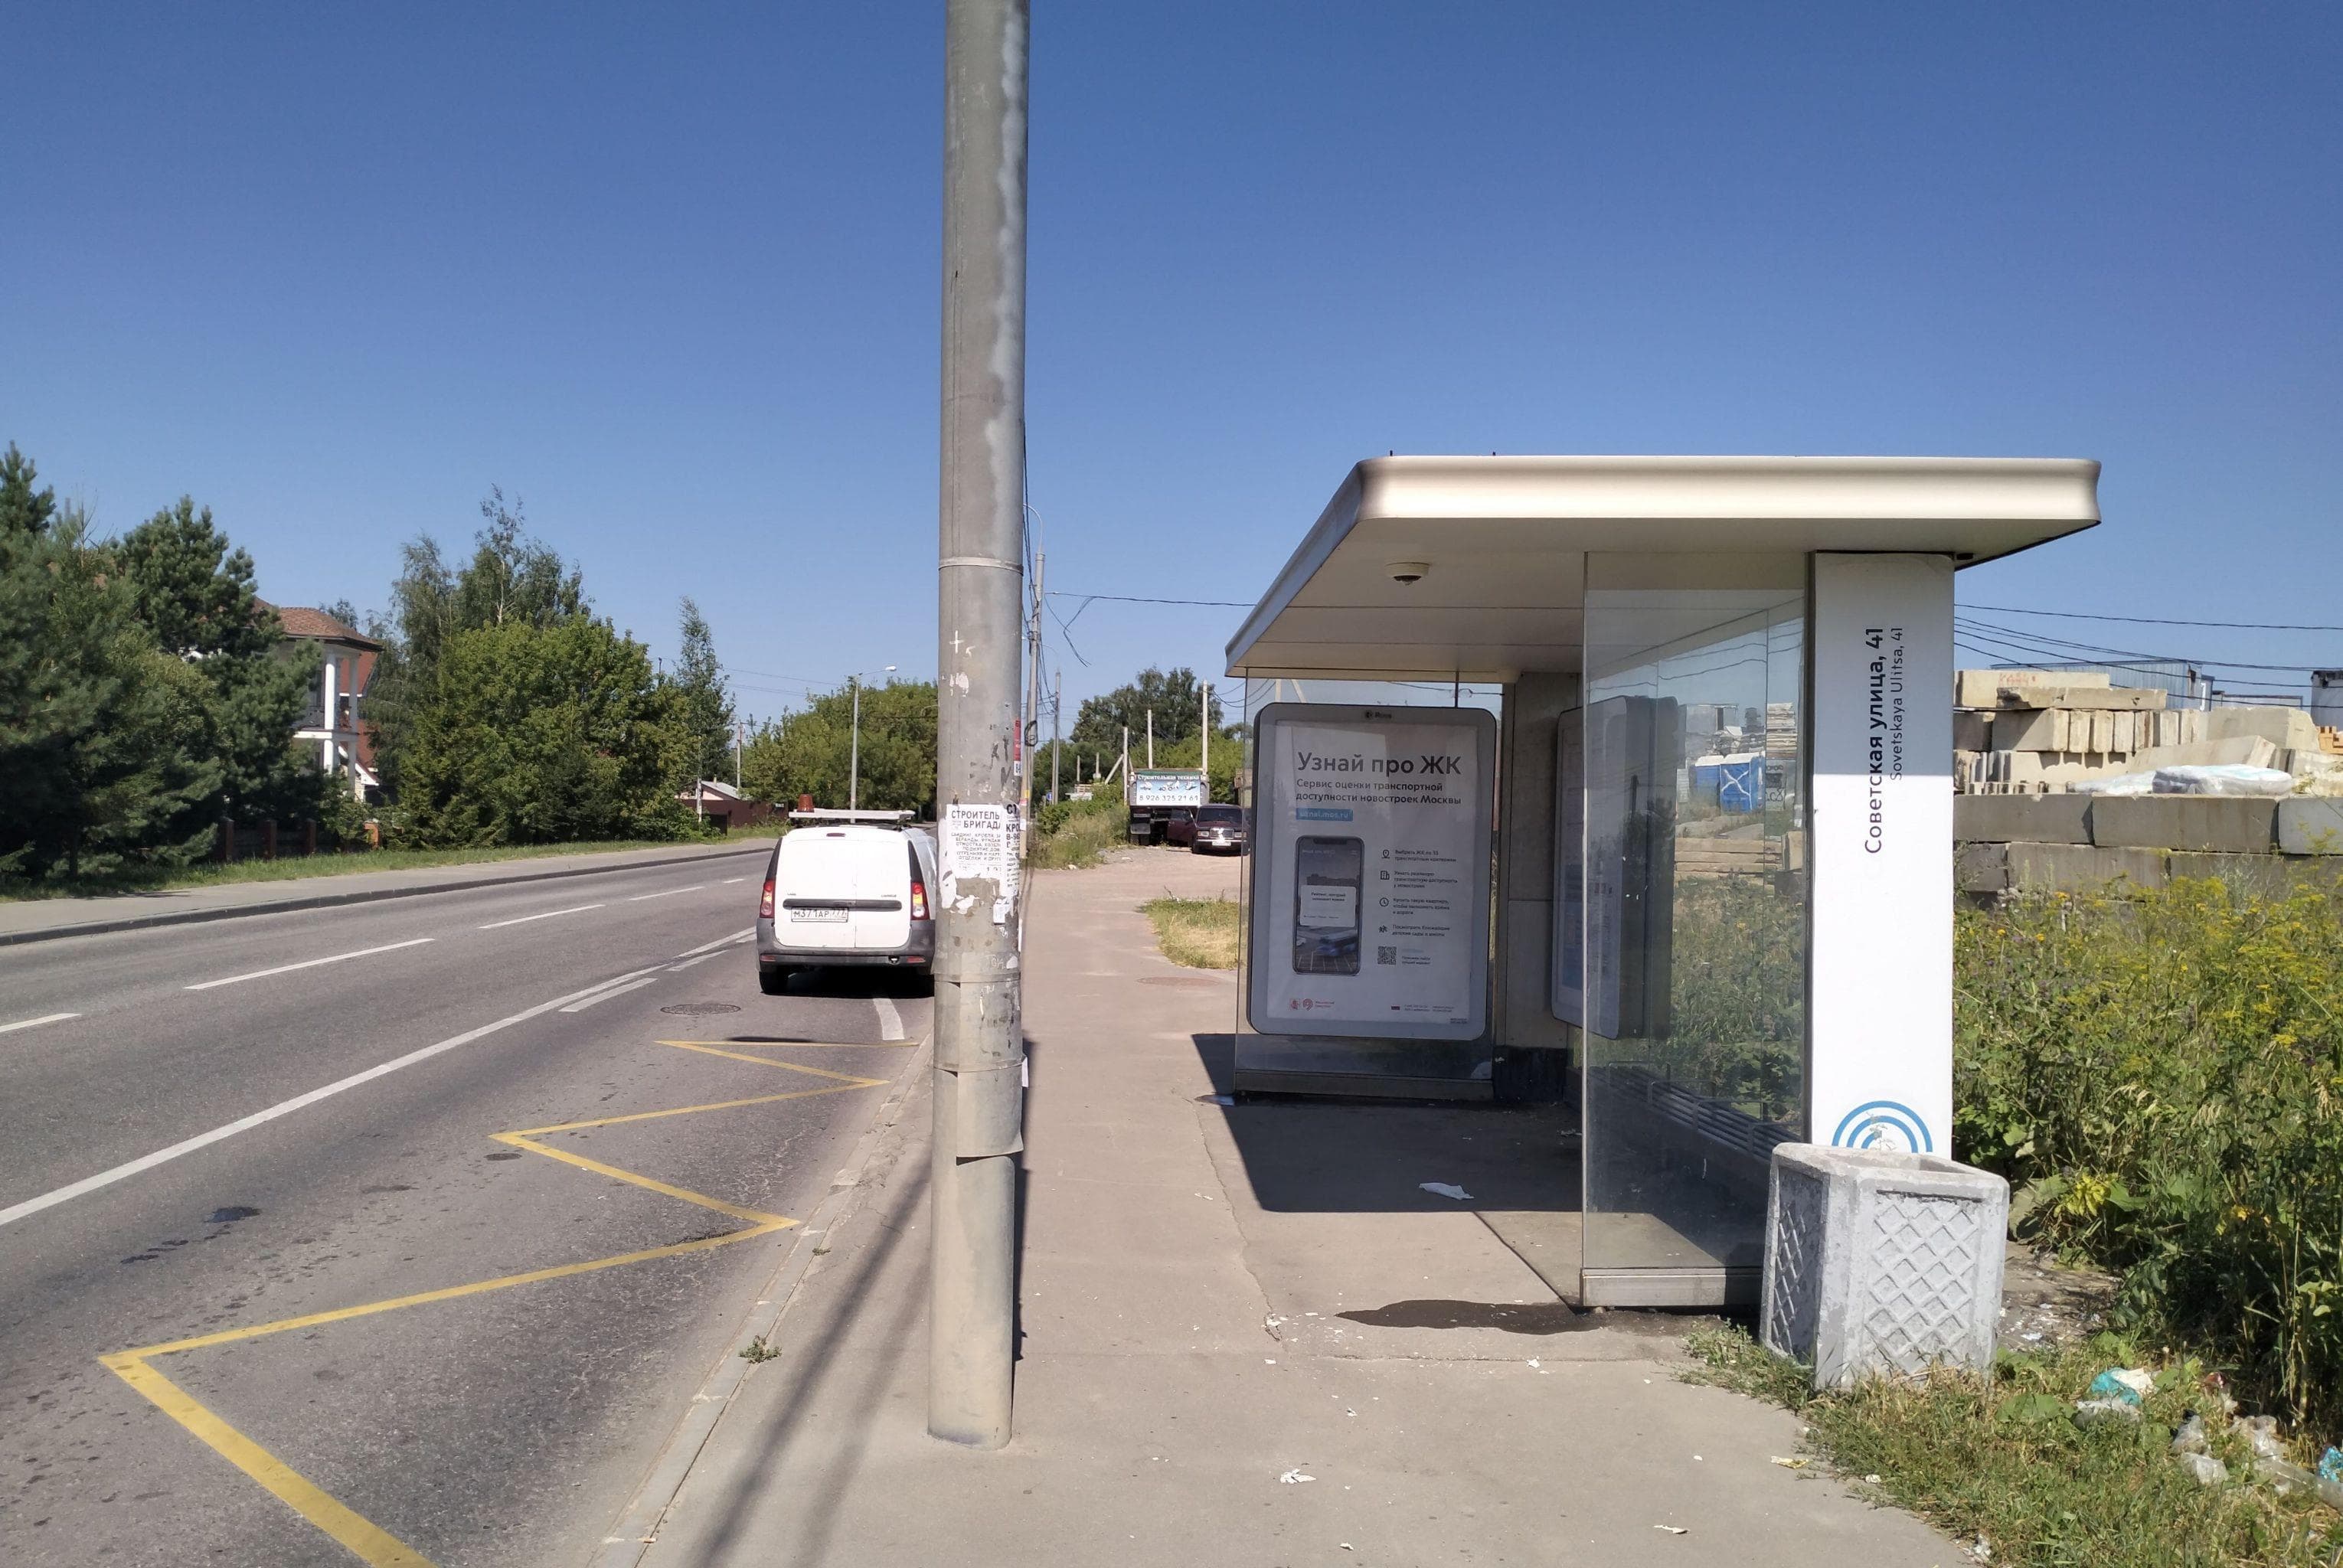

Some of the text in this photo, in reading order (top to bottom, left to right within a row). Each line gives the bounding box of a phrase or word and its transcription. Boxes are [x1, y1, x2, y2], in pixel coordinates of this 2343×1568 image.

[1890, 629, 1905, 780] Sovetskaya Ulitsa, 41
[1865, 629, 1887, 853] Советская улица, 41
[1298, 752, 1461, 777] Узнай про ЖК
[1297, 779, 1443, 792] Сервис оценки транспортной
[1296, 793, 1461, 804] доступности новостроек Москвы
[952, 811, 999, 819] СТРОИТЕЛЬ
